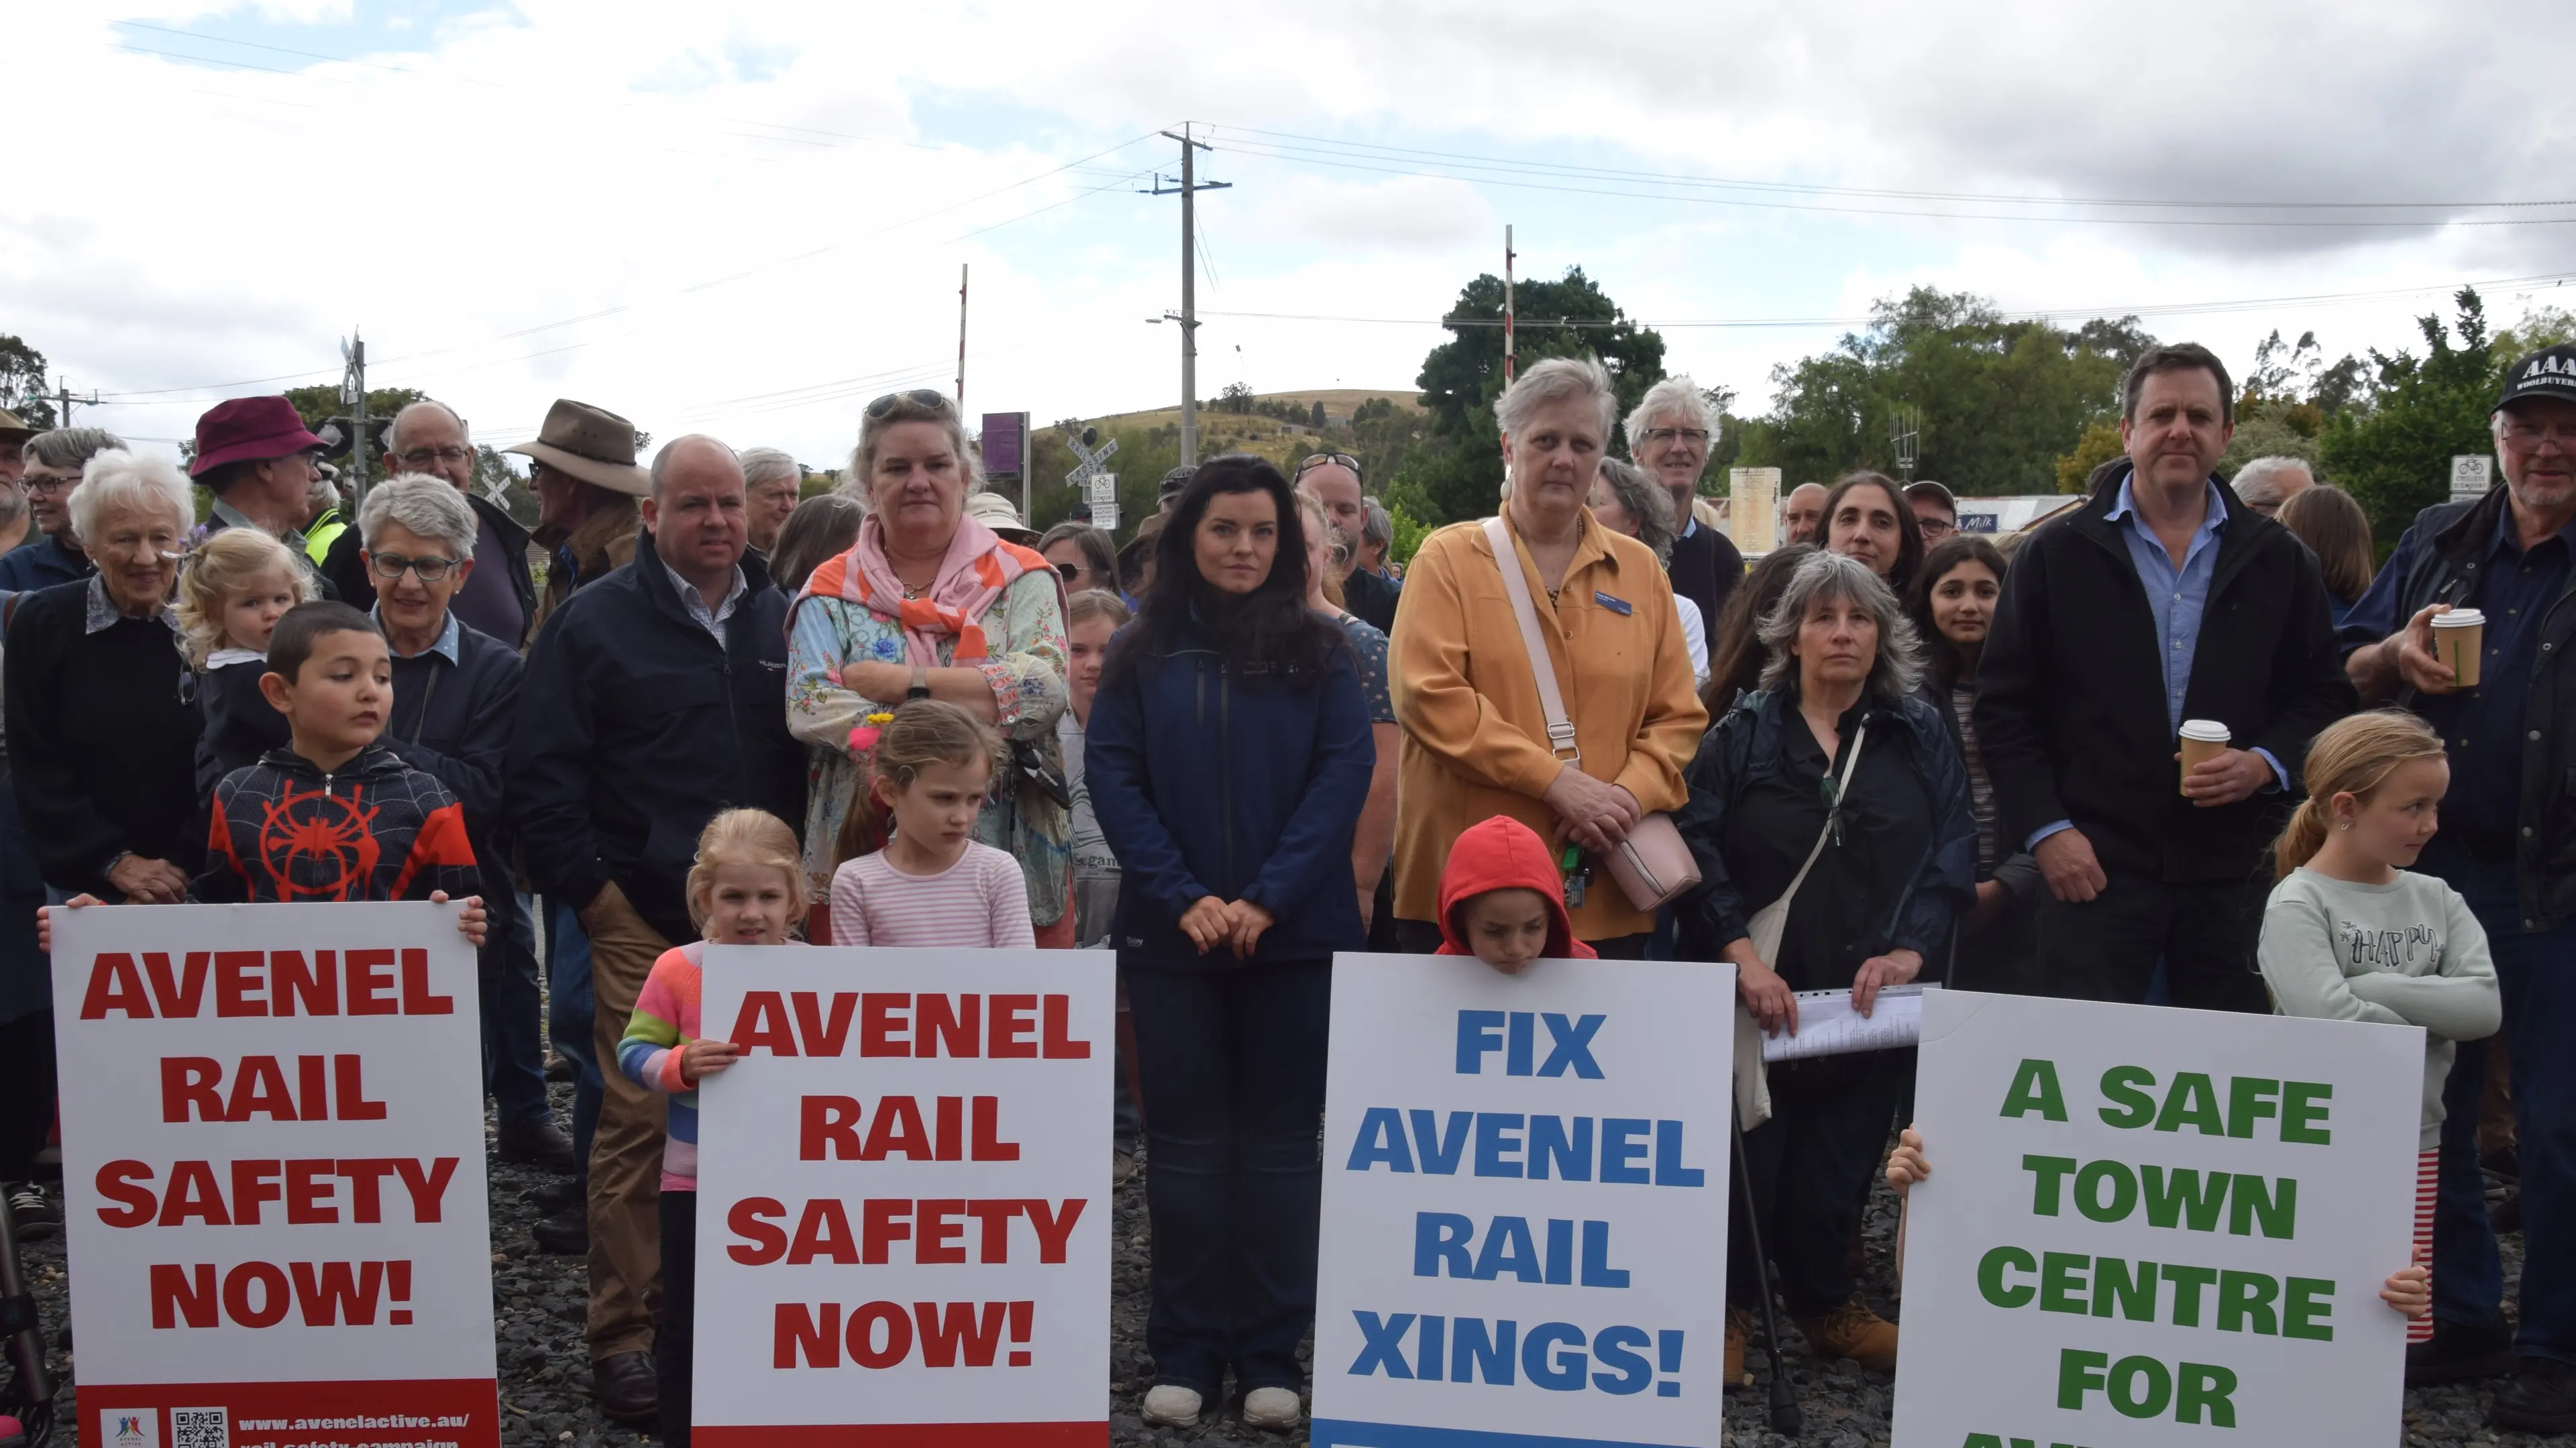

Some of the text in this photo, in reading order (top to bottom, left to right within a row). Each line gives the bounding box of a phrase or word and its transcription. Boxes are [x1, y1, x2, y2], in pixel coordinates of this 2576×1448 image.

[2522, 355, 2576, 379] AAA
[1070, 443, 1114, 483] CROSSING
[1965, 516, 1992, 529] Milk
[2352, 922, 2438, 967] HAPPY
[80, 948, 454, 1020] AVENEL
[729, 991, 1091, 1060] AVENEL
[1456, 1009, 1607, 1080] FIX
[160, 1054, 387, 1123] RAIL
[2000, 1058, 2332, 1145] A SAFE
[800, 1095, 1020, 1162] RAIL
[1346, 1107, 1705, 1188] AVENEL
[95, 1157, 460, 1229] SAFETY
[2024, 1155, 2297, 1239] TOWN
[727, 1196, 1088, 1266] SAFETY
[1413, 1211, 1631, 1288] RAIL
[150, 1260, 413, 1329] NOW!
[1978, 1247, 2336, 1341] CENTRE
[773, 1300, 1034, 1370] NOW!
[1347, 1310, 1684, 1398] XINGS!
[239, 1413, 470, 1431] www.avenelactive.au/
[2057, 1348, 2238, 1428] FOR
